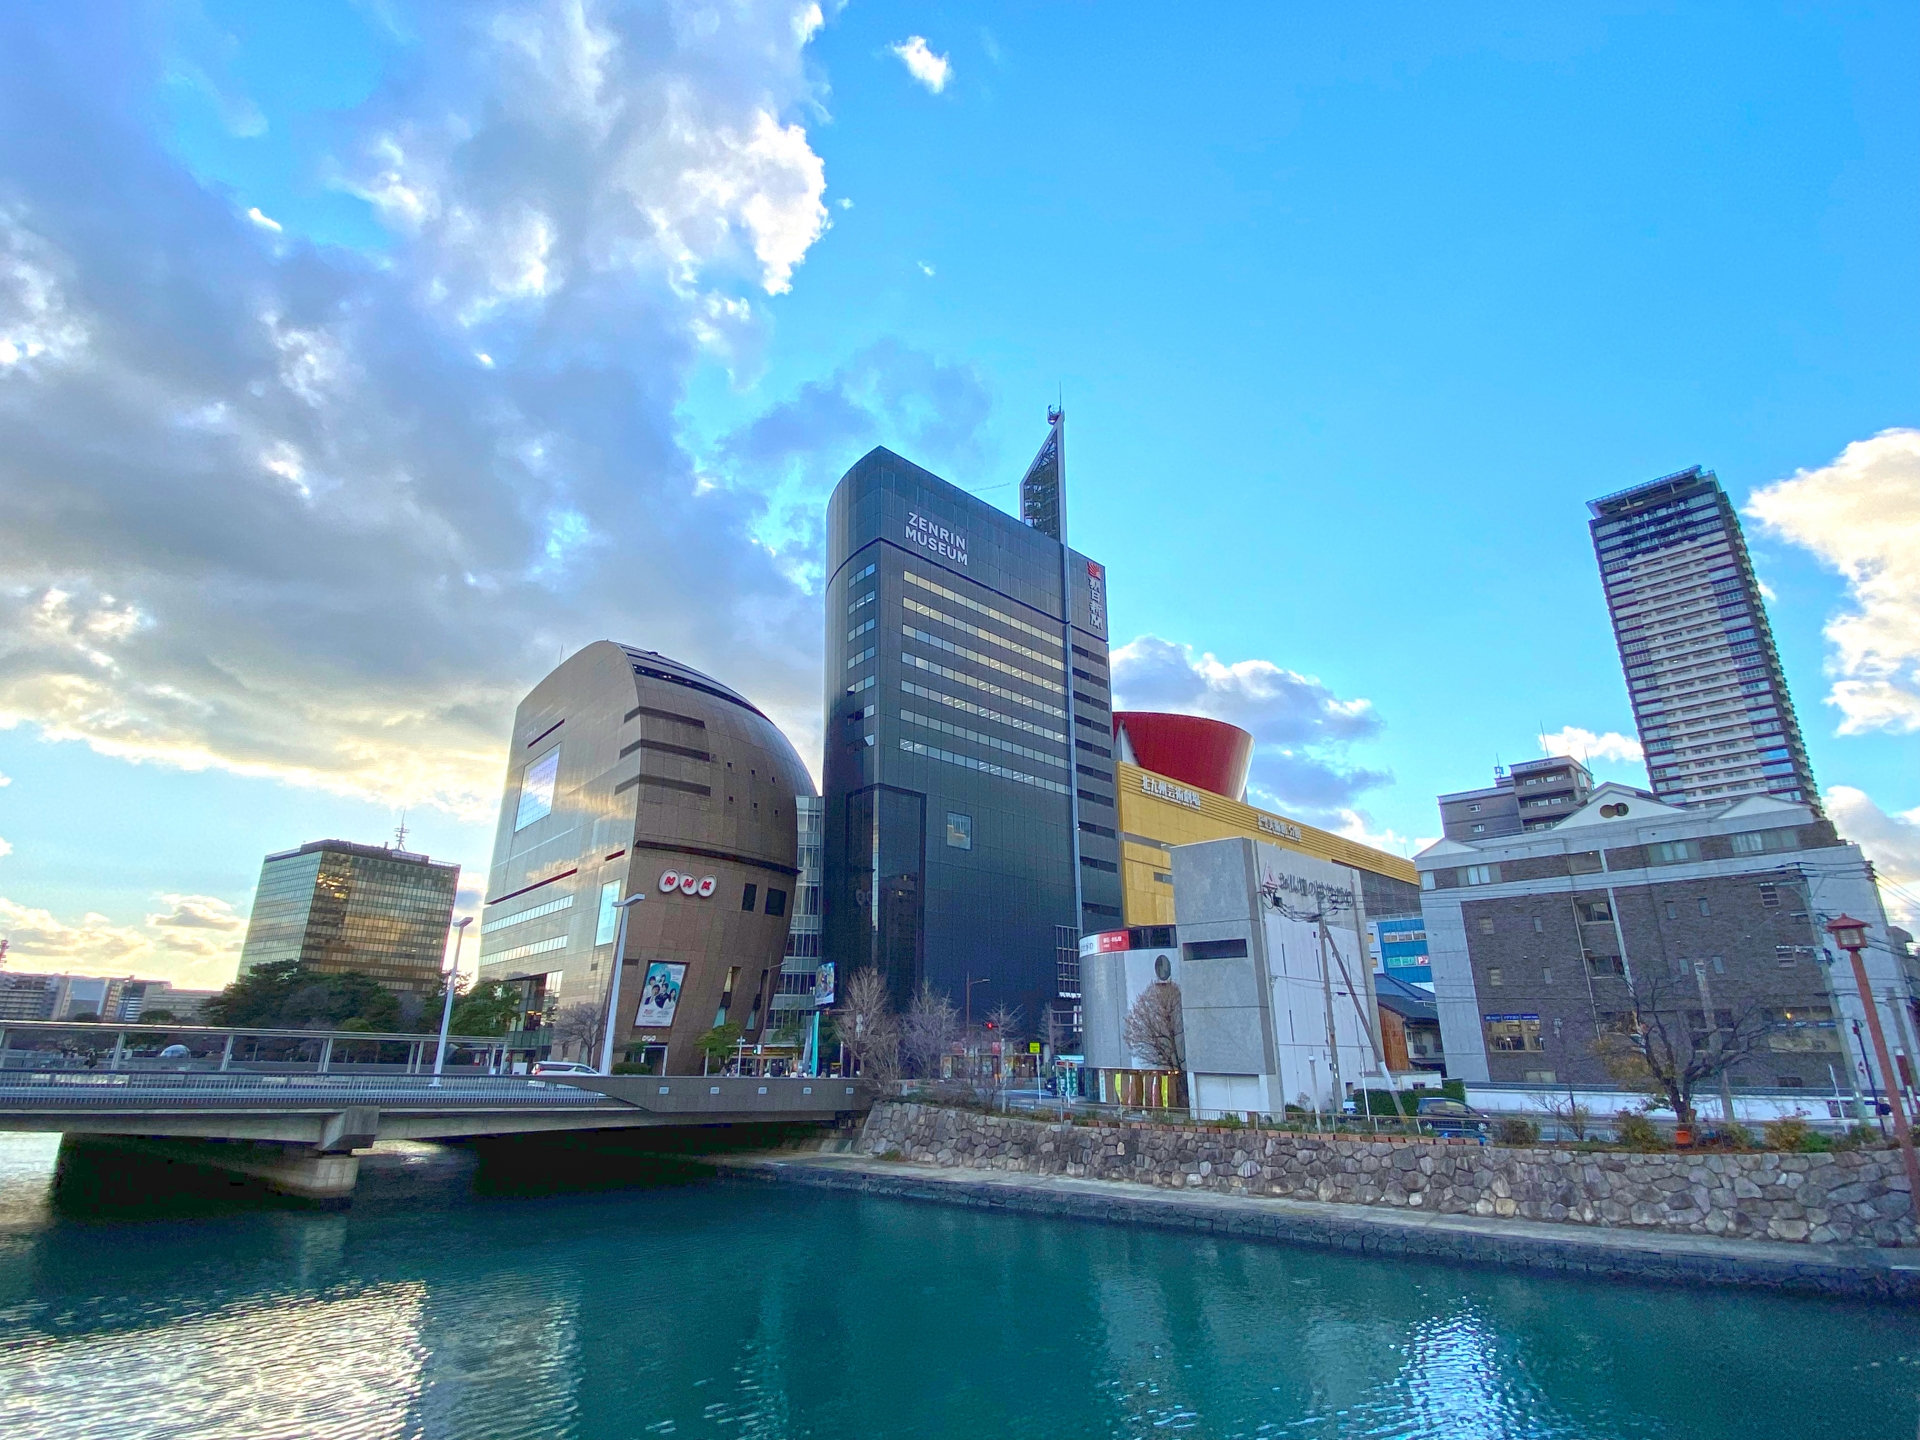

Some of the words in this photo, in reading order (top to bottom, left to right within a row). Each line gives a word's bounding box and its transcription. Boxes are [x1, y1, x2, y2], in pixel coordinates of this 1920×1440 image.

[905, 525, 968, 566] MUSEUM
[908, 511, 966, 551] ZENRIN
[1142, 775, 1201, 808] 北九州芸術劇場
[662, 873, 713, 893] NHK
